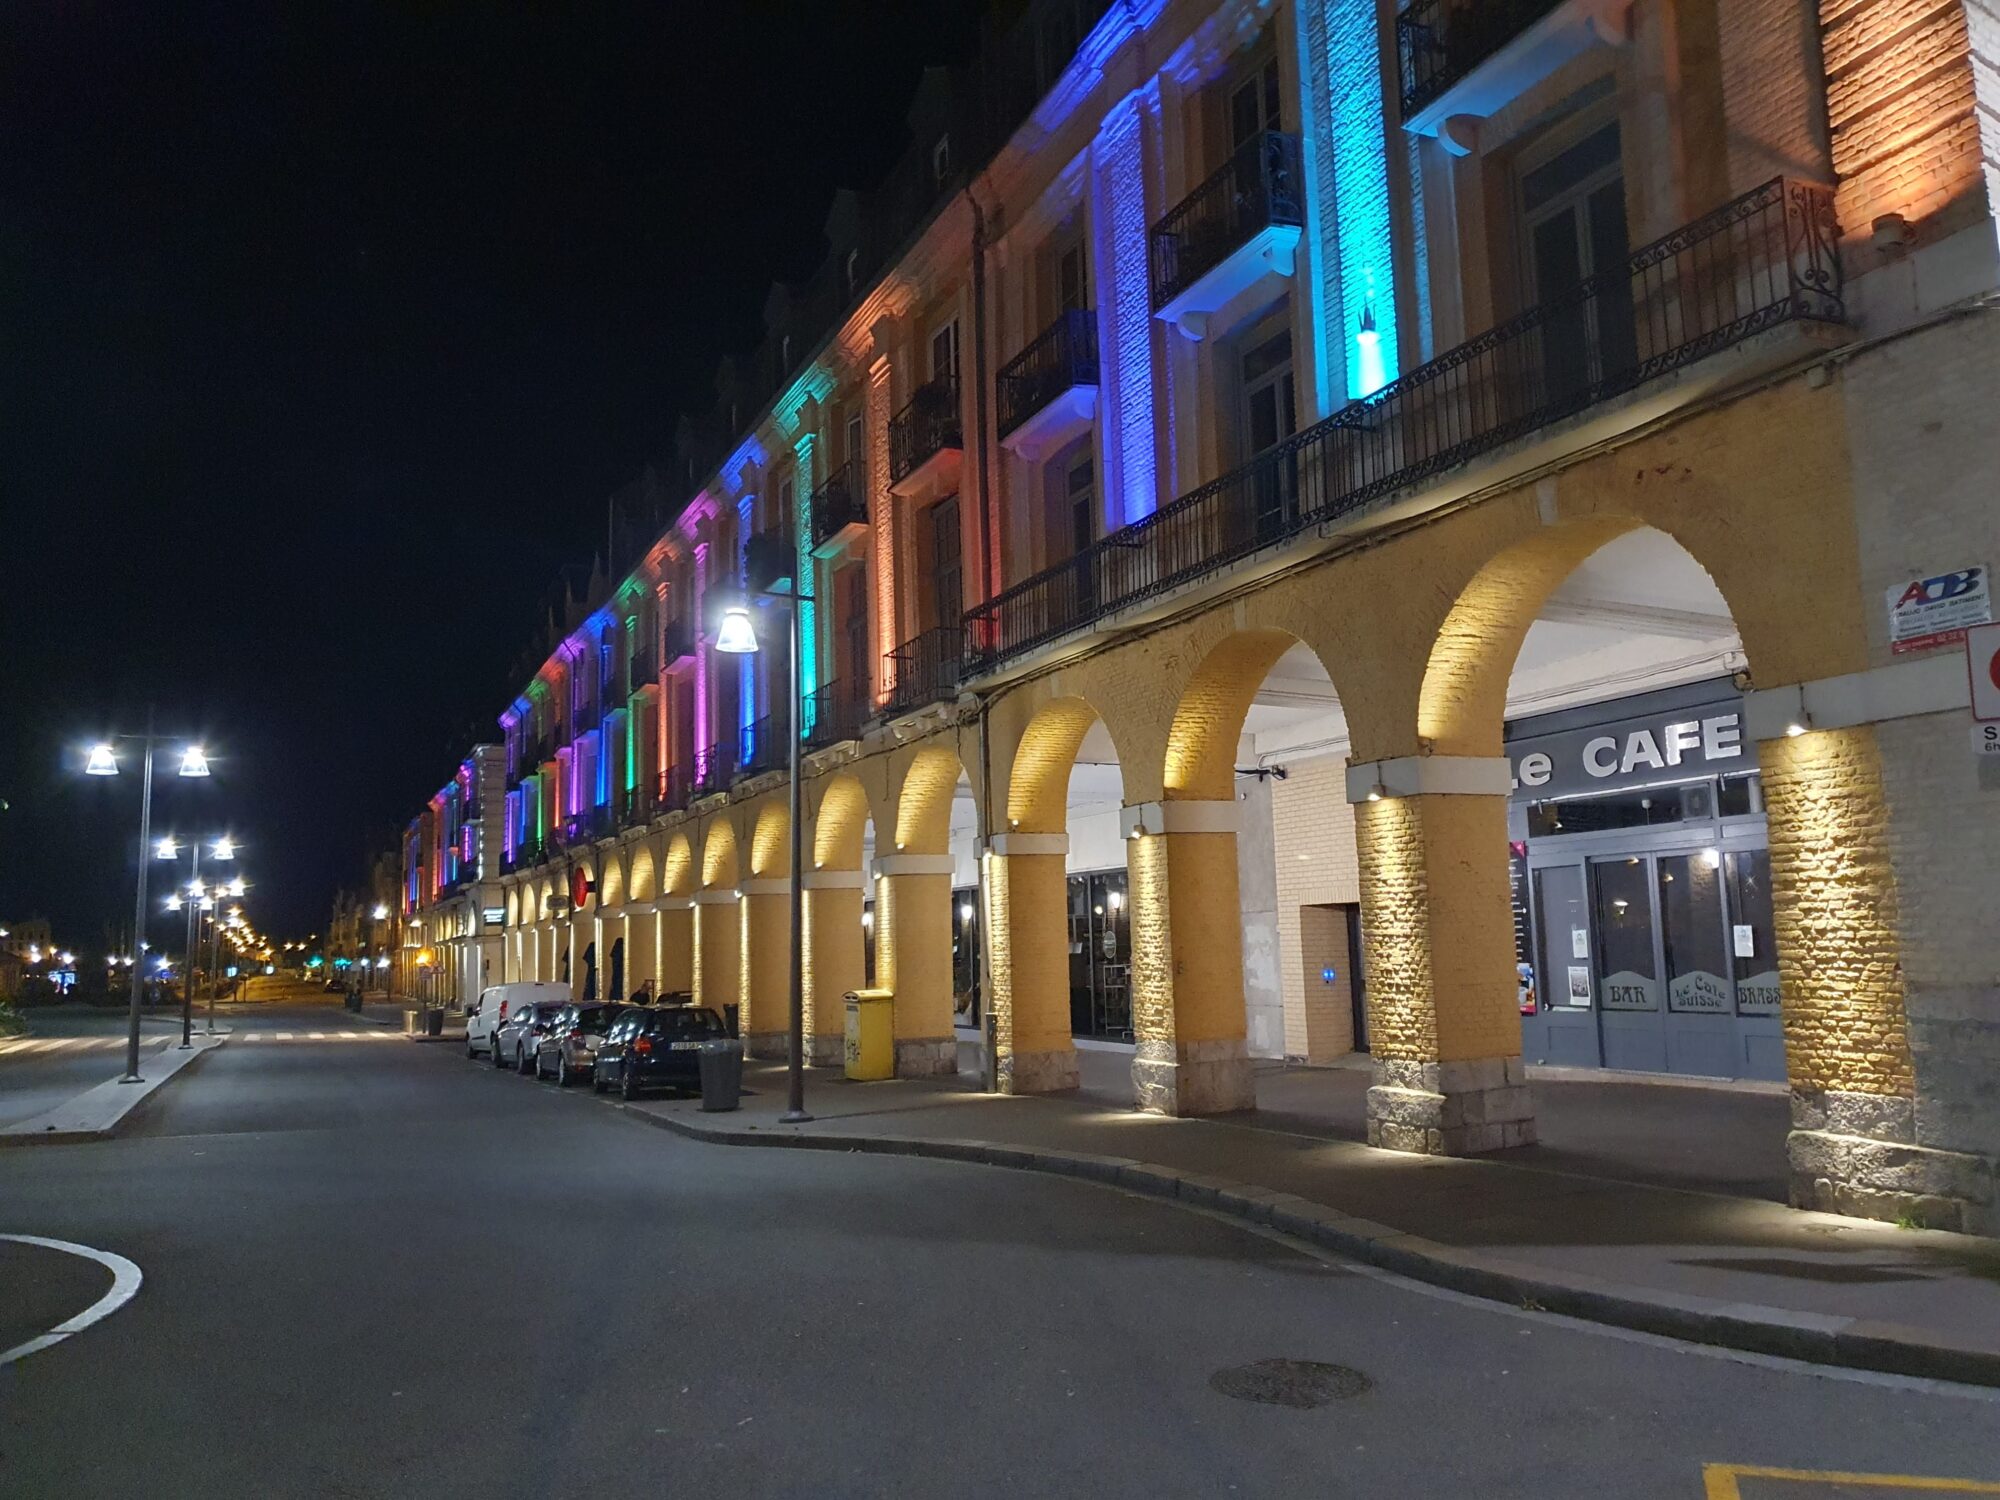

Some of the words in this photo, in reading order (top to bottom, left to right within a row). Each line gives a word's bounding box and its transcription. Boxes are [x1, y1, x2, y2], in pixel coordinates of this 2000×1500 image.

[1893, 567, 1982, 611] ADB
[1582, 713, 1742, 778] CAFE
[1609, 985, 1647, 1003] BAR
